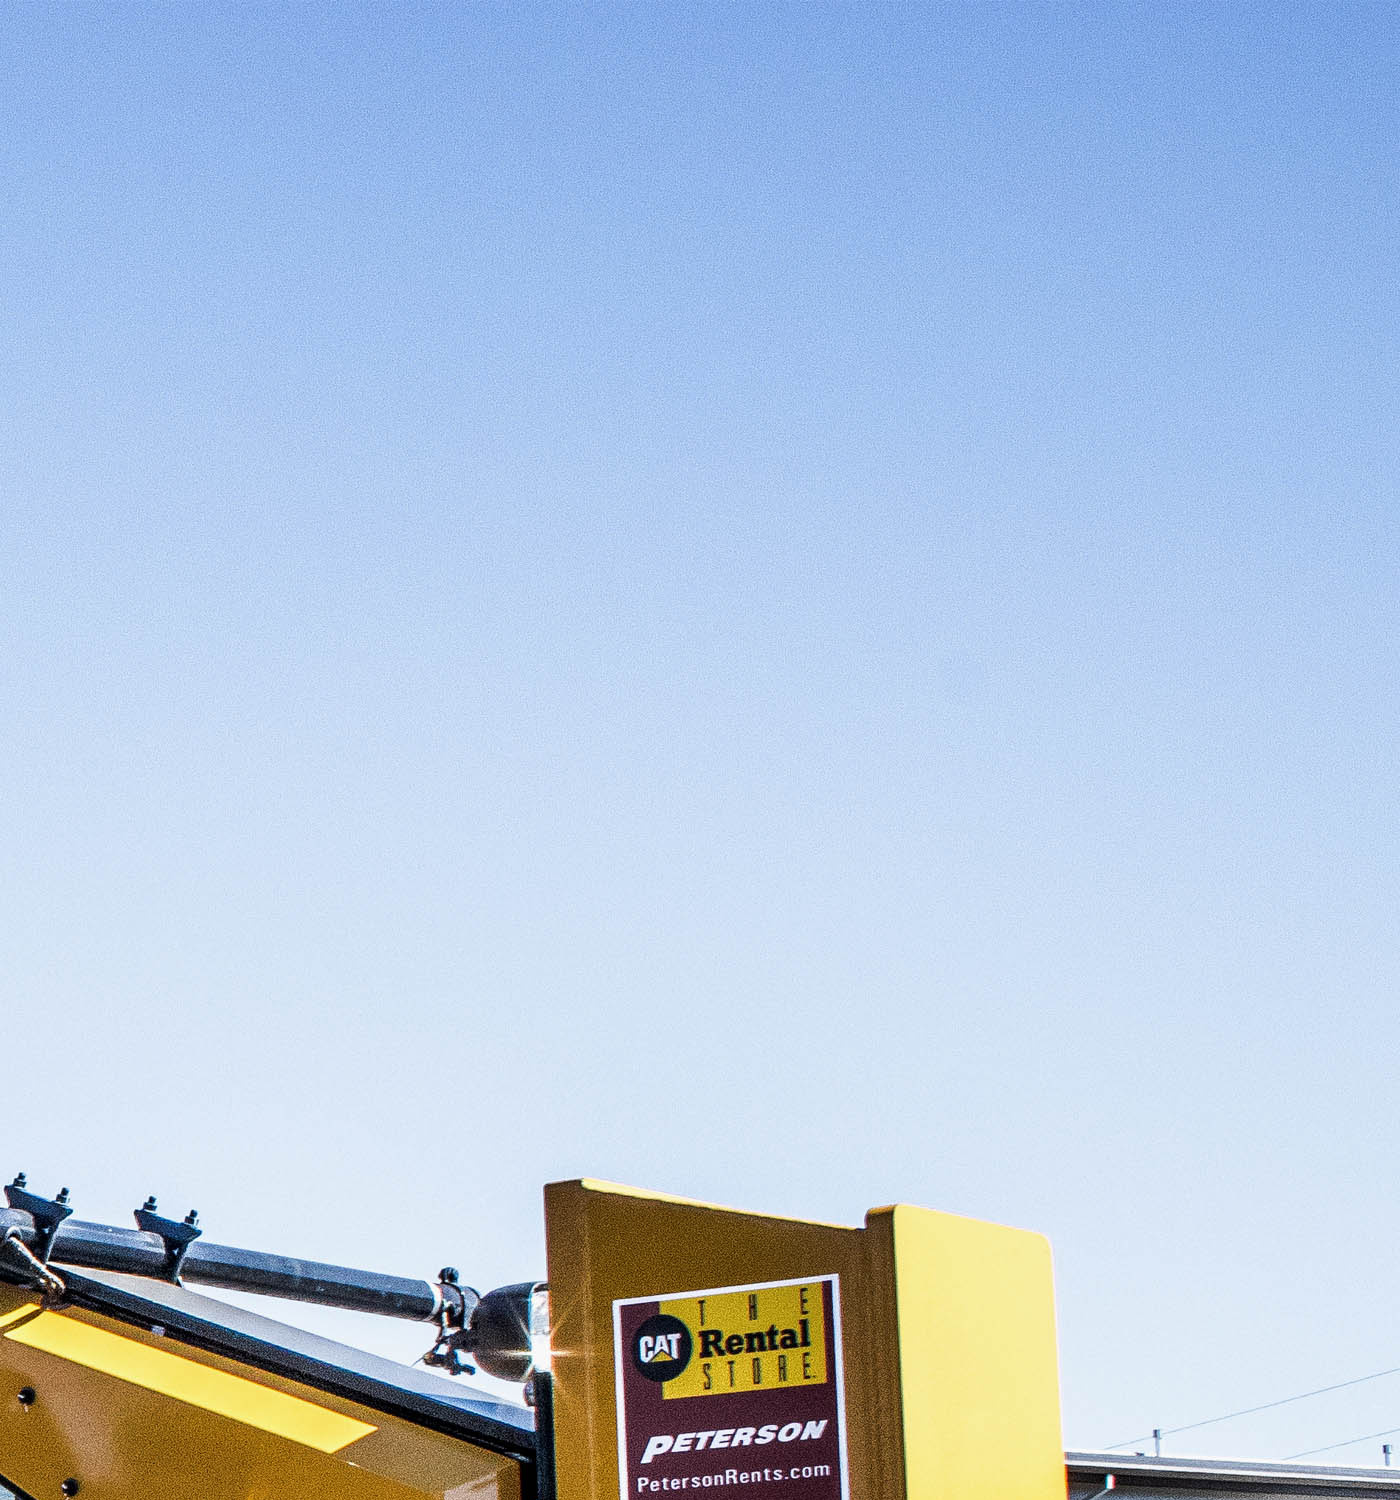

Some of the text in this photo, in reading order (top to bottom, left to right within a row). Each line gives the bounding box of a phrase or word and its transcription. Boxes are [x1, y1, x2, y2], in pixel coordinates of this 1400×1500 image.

[639, 1332, 682, 1364] CAT
[699, 1318, 811, 1359] Rental
[703, 1352, 811, 1390] STORE
[640, 1419, 829, 1464] PETERSON
[637, 1463, 831, 1493] PetersonRents.com
